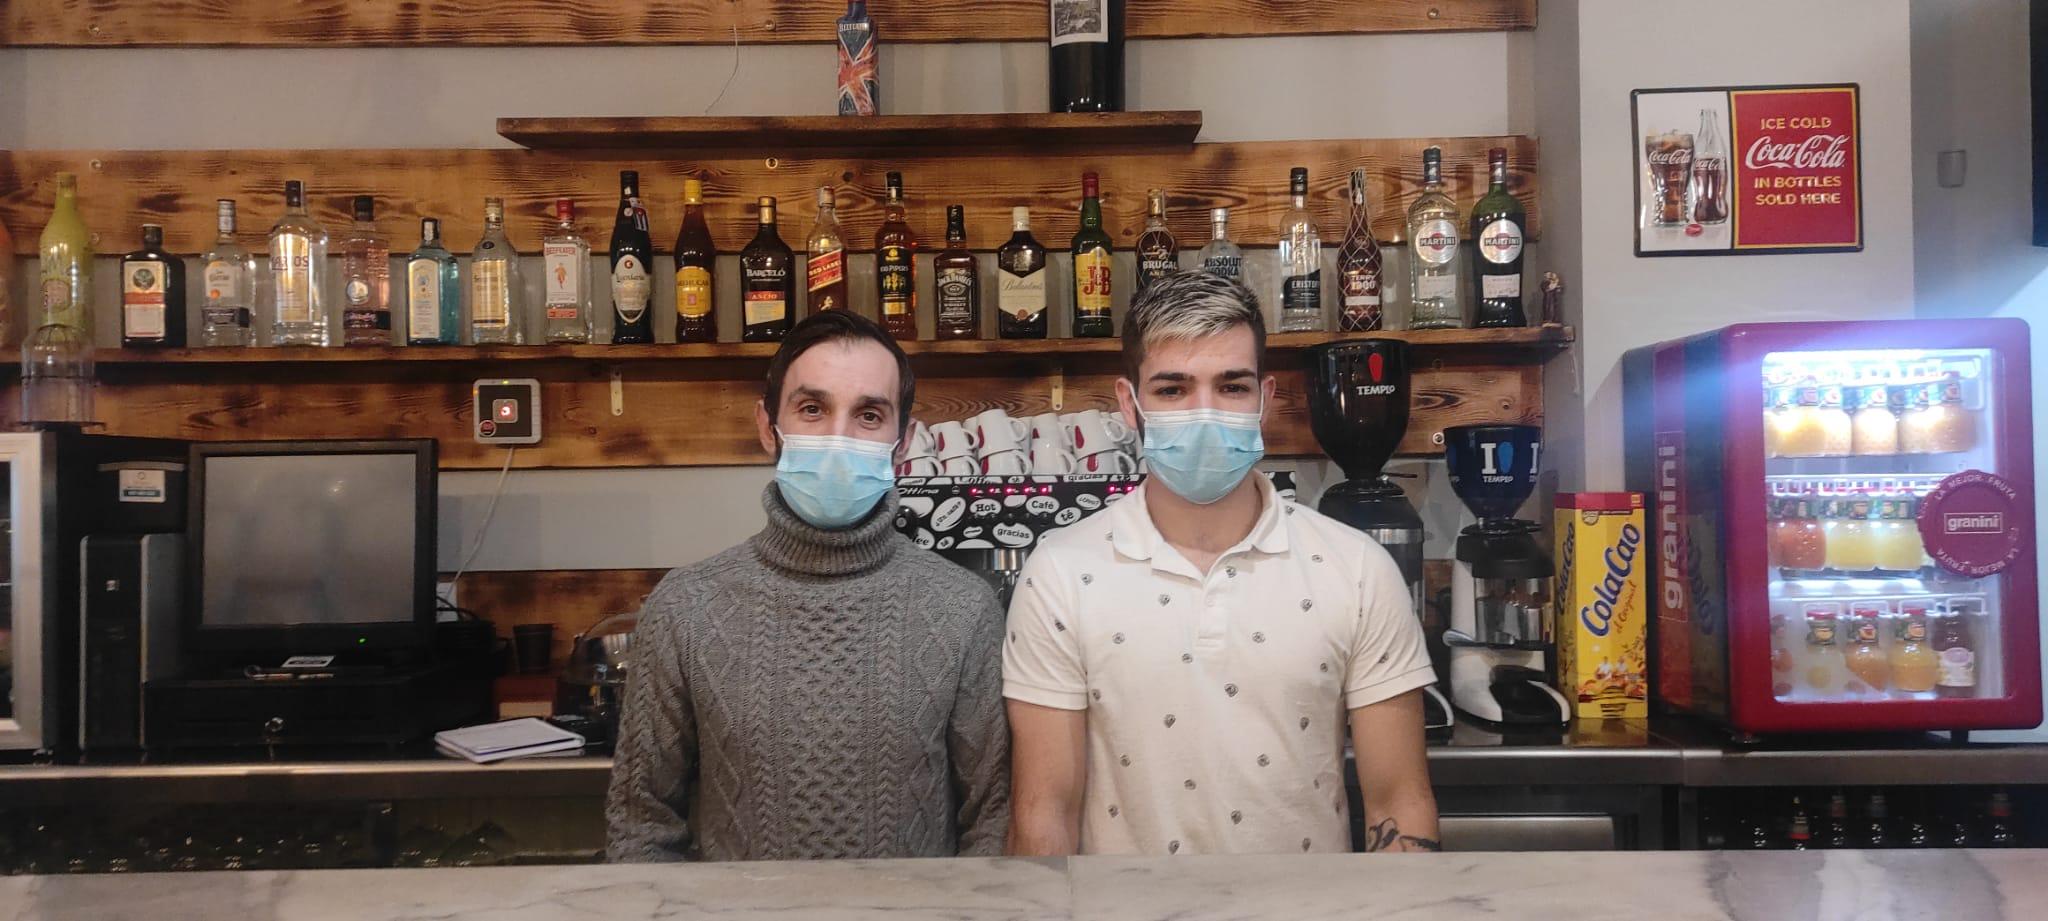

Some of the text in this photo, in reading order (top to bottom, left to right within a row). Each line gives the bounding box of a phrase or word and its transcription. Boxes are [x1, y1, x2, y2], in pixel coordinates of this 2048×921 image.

[1760, 117, 1832, 130] ICE COLD
[1745, 134, 1849, 170] Coca-Cola
[1754, 176, 1842, 189] IN BOTTLES
[1755, 193, 1841, 206] SOLD HERE
[1420, 238, 1455, 246] MARTINI
[1484, 237, 1520, 246] MARTINI
[1143, 260, 1177, 270] BRUGAL
[1204, 257, 1242, 267] ABSOLUT
[1480, 442, 1497, 475] I
[976, 503, 996, 512] Hot
[1031, 500, 1054, 509] Café
[1658, 445, 1684, 610] granini
[1947, 515, 1998, 531] granini
[997, 528, 1030, 540] gracias
[1581, 523, 1640, 637] ColaCao
